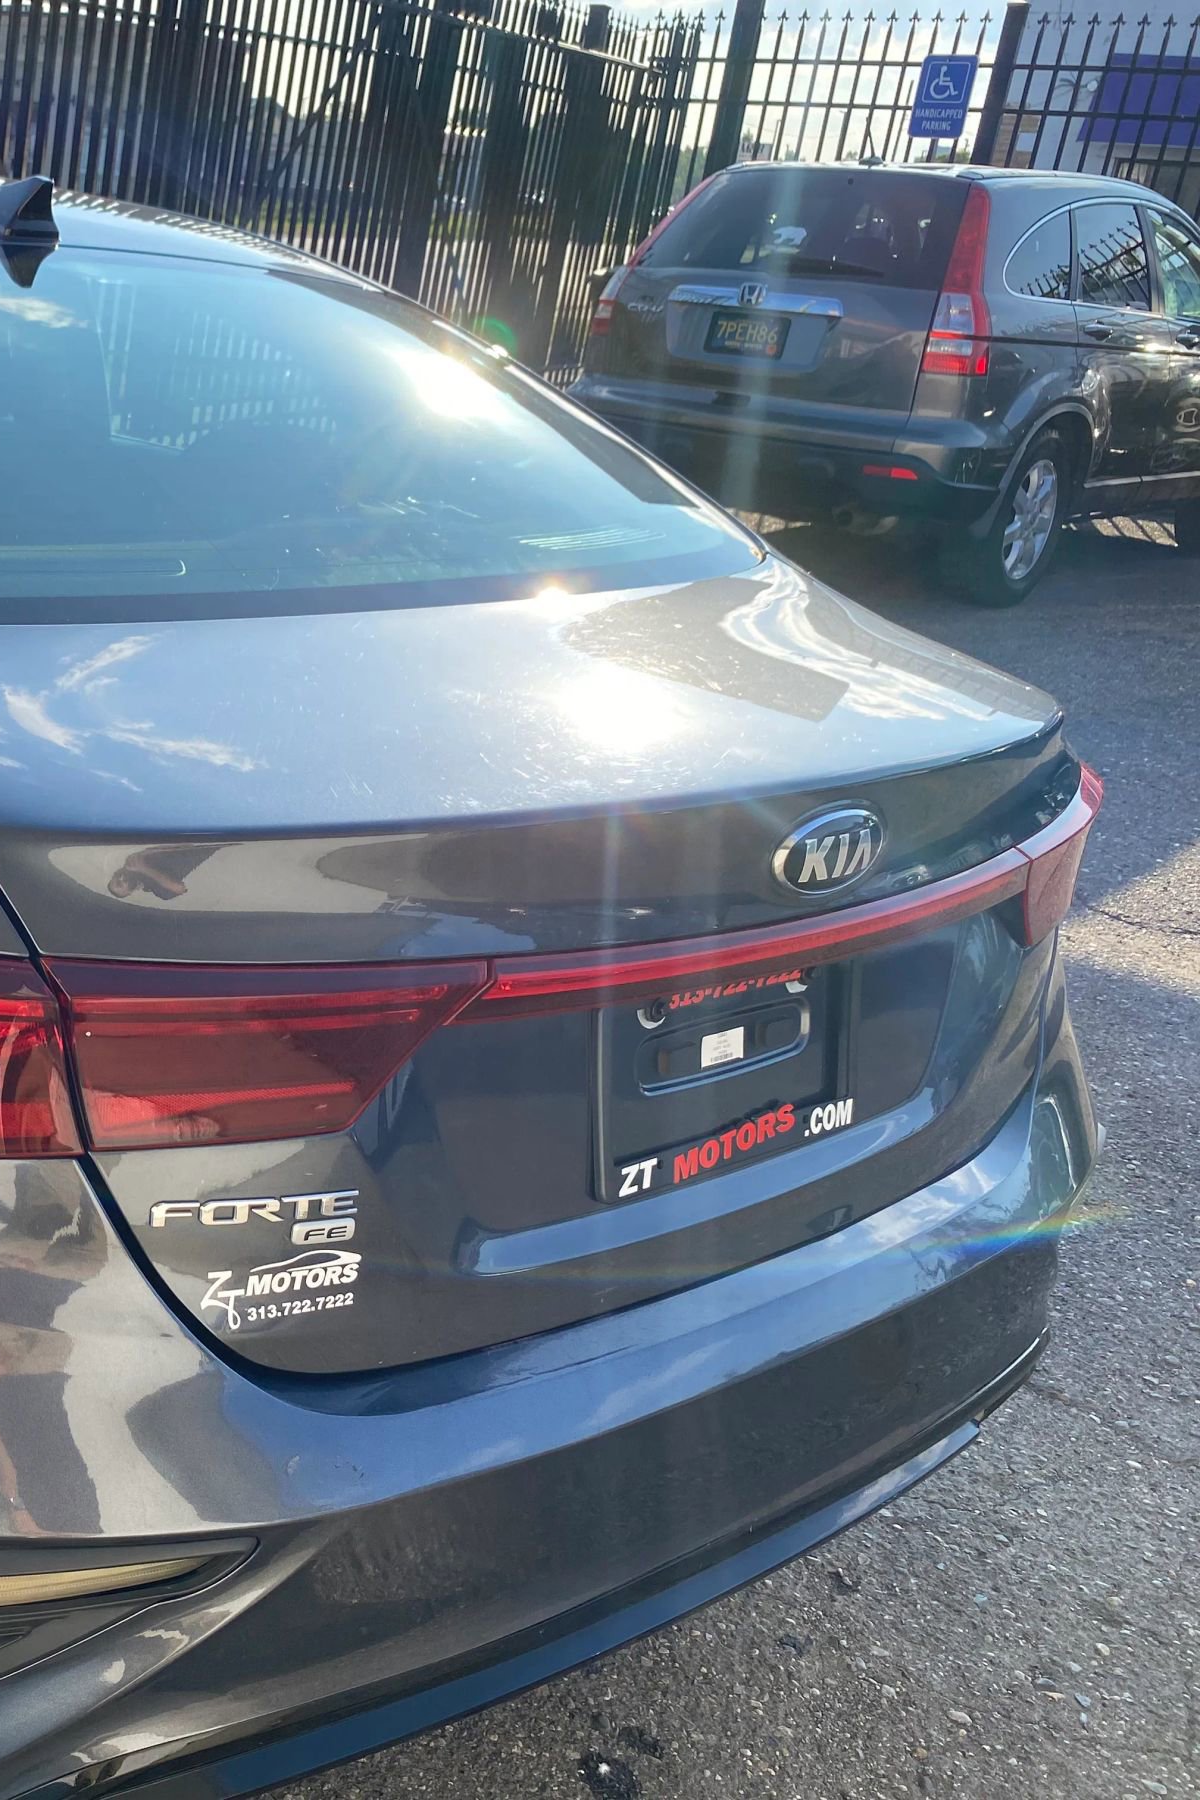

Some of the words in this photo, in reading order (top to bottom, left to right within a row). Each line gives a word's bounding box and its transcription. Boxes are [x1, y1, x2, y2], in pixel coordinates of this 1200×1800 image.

[915, 108, 963, 119] HANDICAPPED
[921, 121, 951, 131] PARKING
[716, 320, 779, 345] 7PEH86
[797, 828, 874, 884] KIA
[618, 1159, 659, 1198] ZT
[673, 1104, 796, 1185] MOTORS
[803, 1098, 855, 1138] .COM
[149, 1189, 360, 1228] FORTE
[303, 1225, 348, 1242] FE
[200, 1270, 245, 1331] ZT
[245, 1263, 360, 1297] MOTORS
[246, 1292, 355, 1322] 313.722.7222
